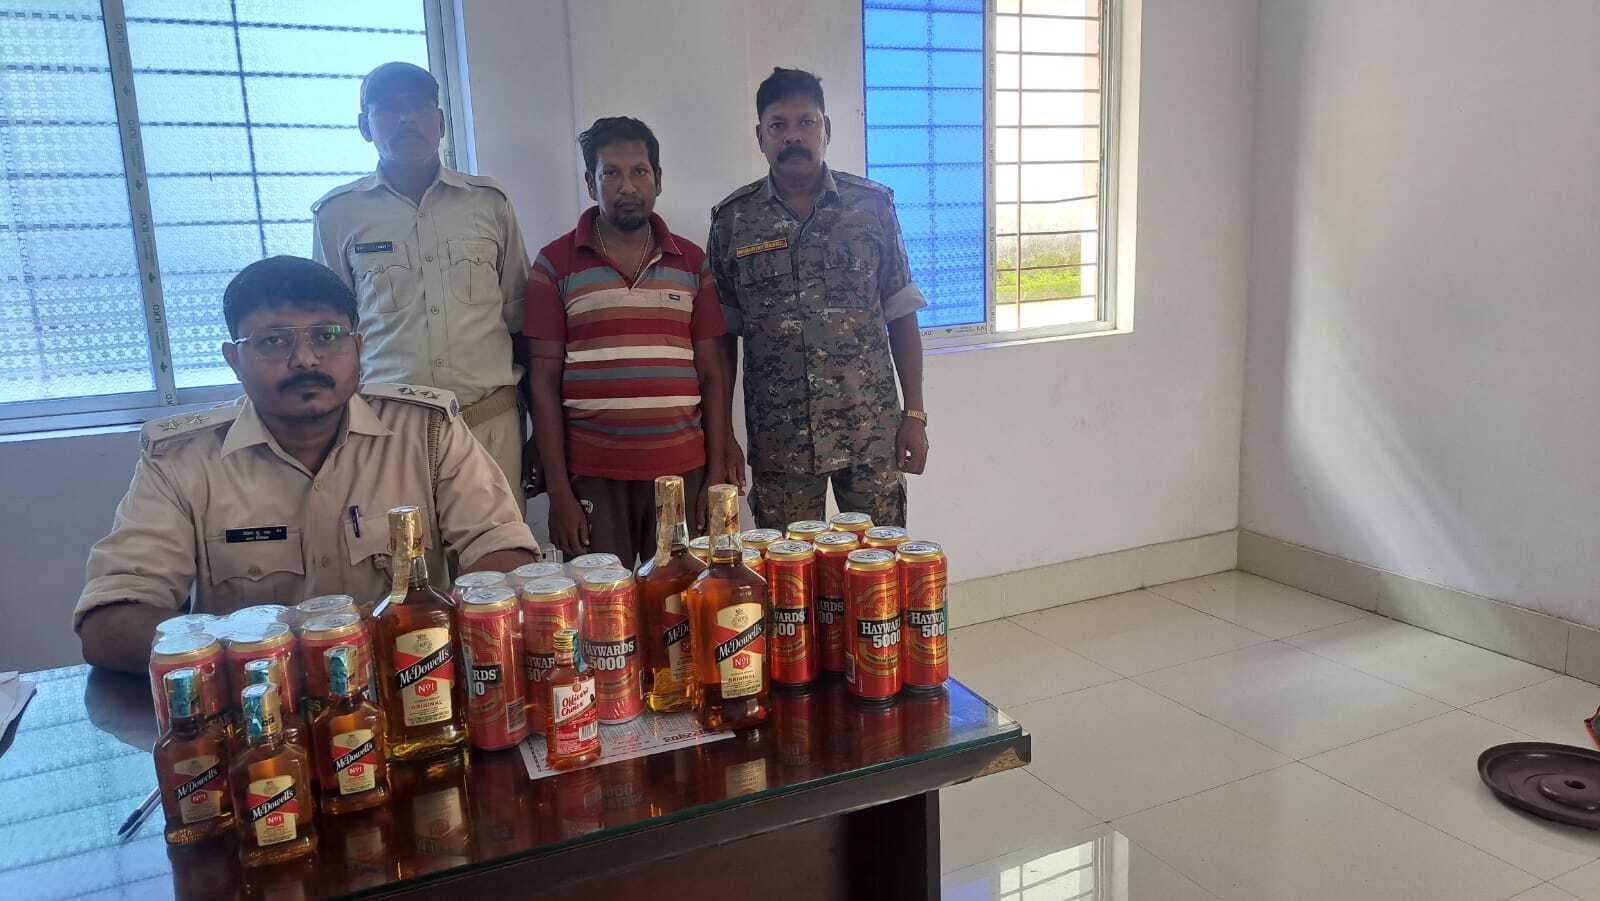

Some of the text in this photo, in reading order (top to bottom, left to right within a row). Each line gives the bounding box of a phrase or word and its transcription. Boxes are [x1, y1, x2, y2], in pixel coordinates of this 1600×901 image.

[775, 609, 806, 623] WARDS
[911, 611, 945, 625] HAYWA
[778, 622, 796, 636] 00
[861, 617, 901, 635] HAYWAR
[921, 622, 945, 638] 500
[400, 648, 450, 688] McDowell's
[591, 656, 626, 671] 5000
